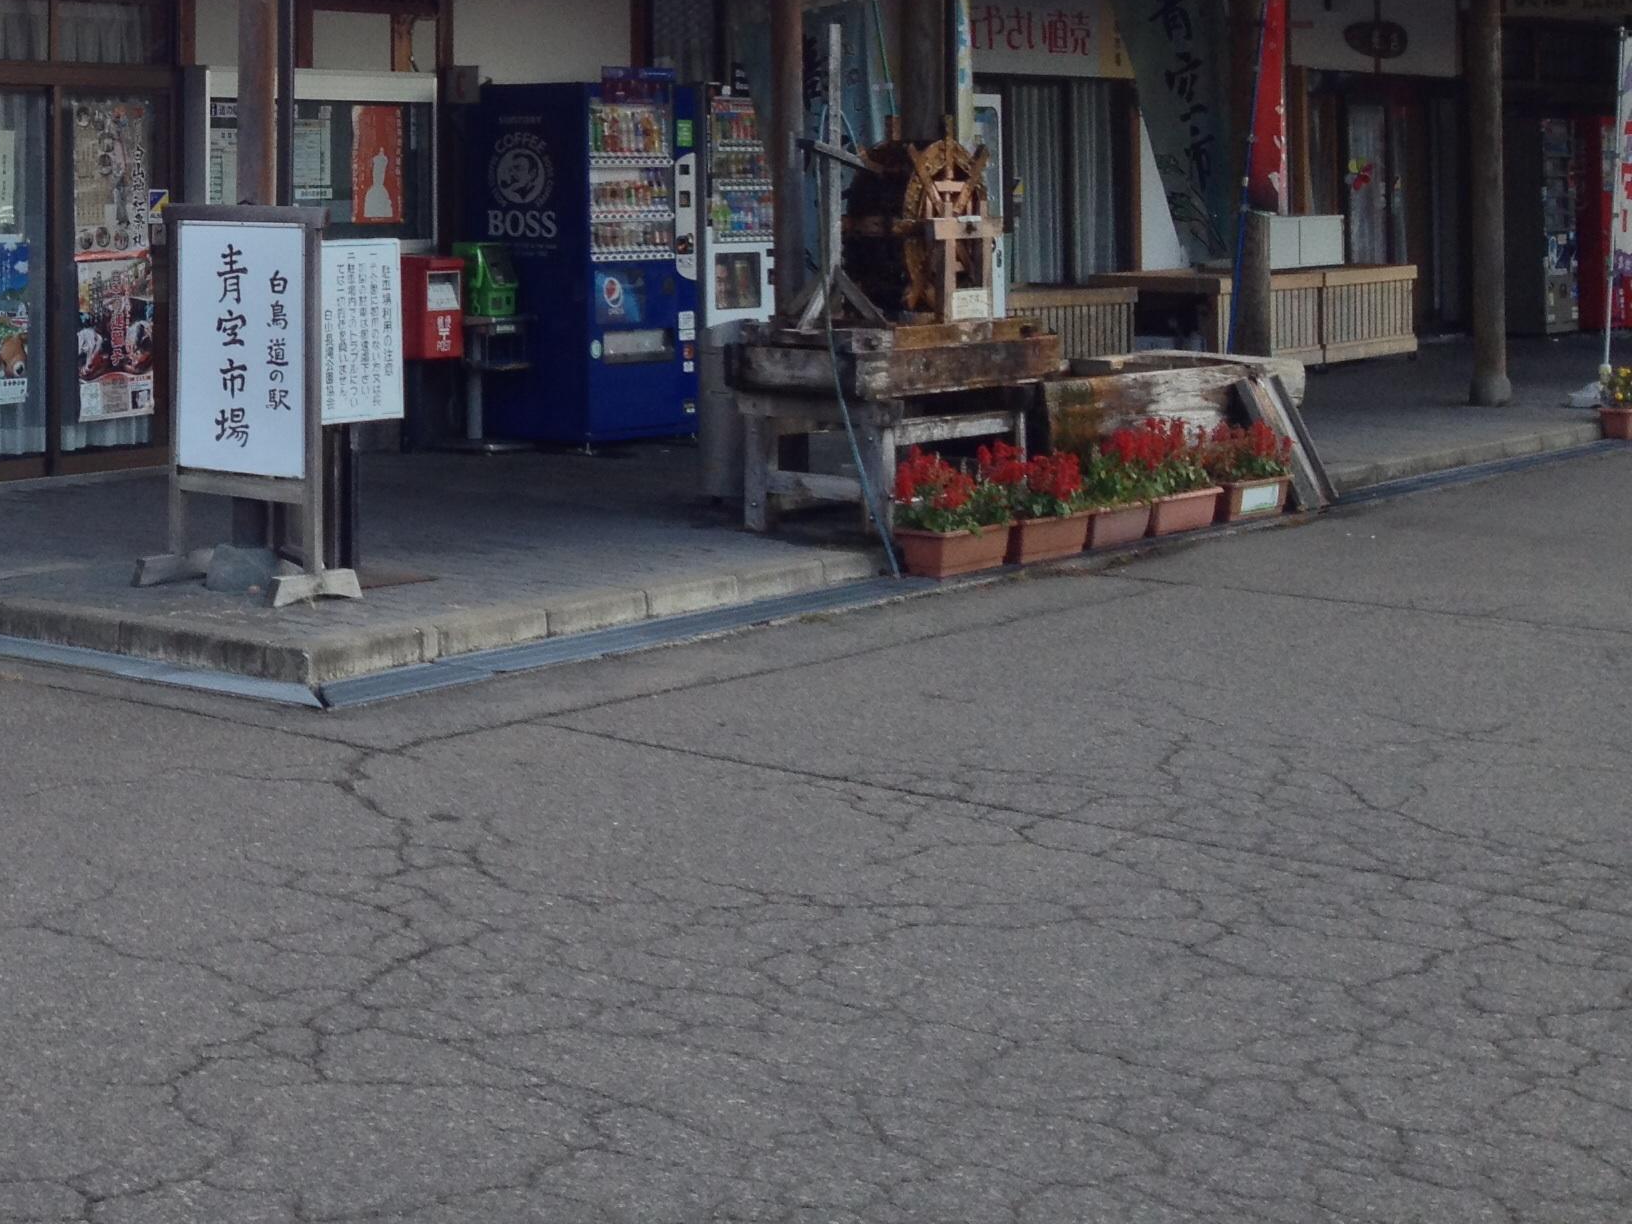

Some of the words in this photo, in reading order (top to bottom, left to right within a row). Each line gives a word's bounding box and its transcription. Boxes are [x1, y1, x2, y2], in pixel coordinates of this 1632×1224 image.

[494, 131, 548, 154] COFFEE
[487, 209, 558, 238] BOSS
[214, 243, 250, 448] 青空市場
[266, 269, 291, 412] 白鳥道の駅
